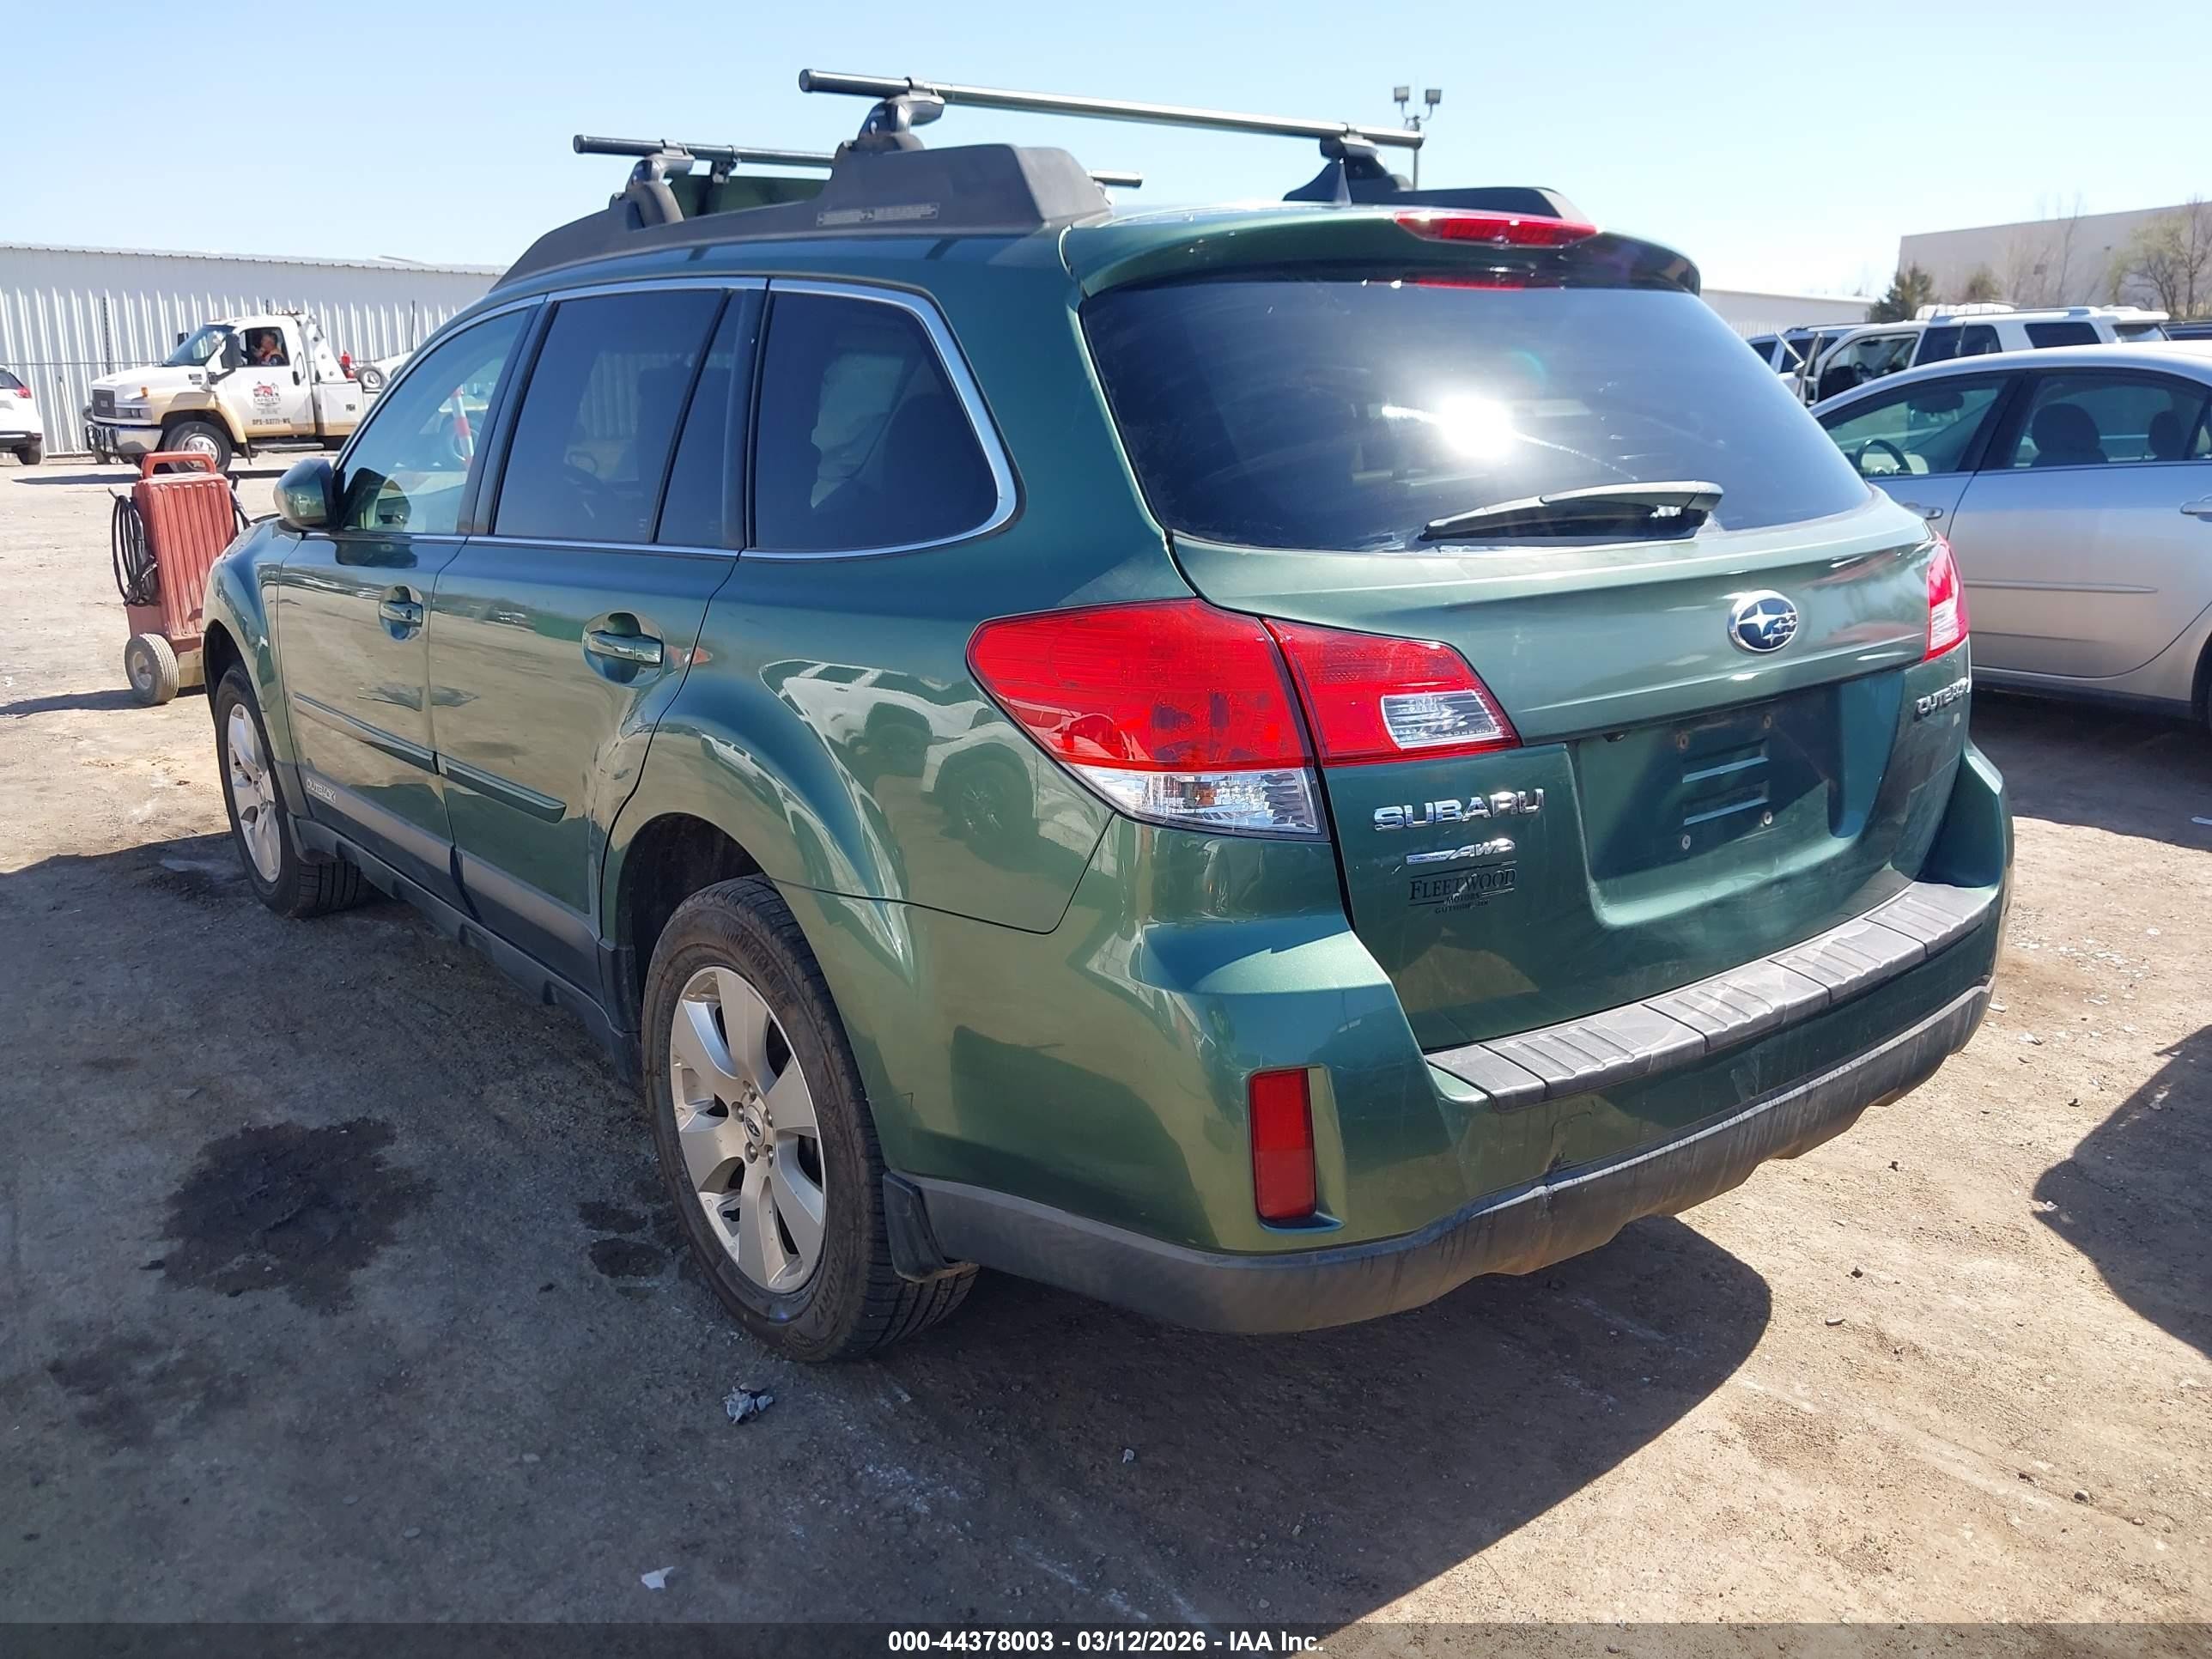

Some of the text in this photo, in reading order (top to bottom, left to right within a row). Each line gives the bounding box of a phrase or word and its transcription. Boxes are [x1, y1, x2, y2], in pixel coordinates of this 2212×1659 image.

[1374, 788, 1544, 831] SUBARU
[1448, 837, 1516, 860] AWD
[1408, 868, 1517, 900] FLEETWOOD
